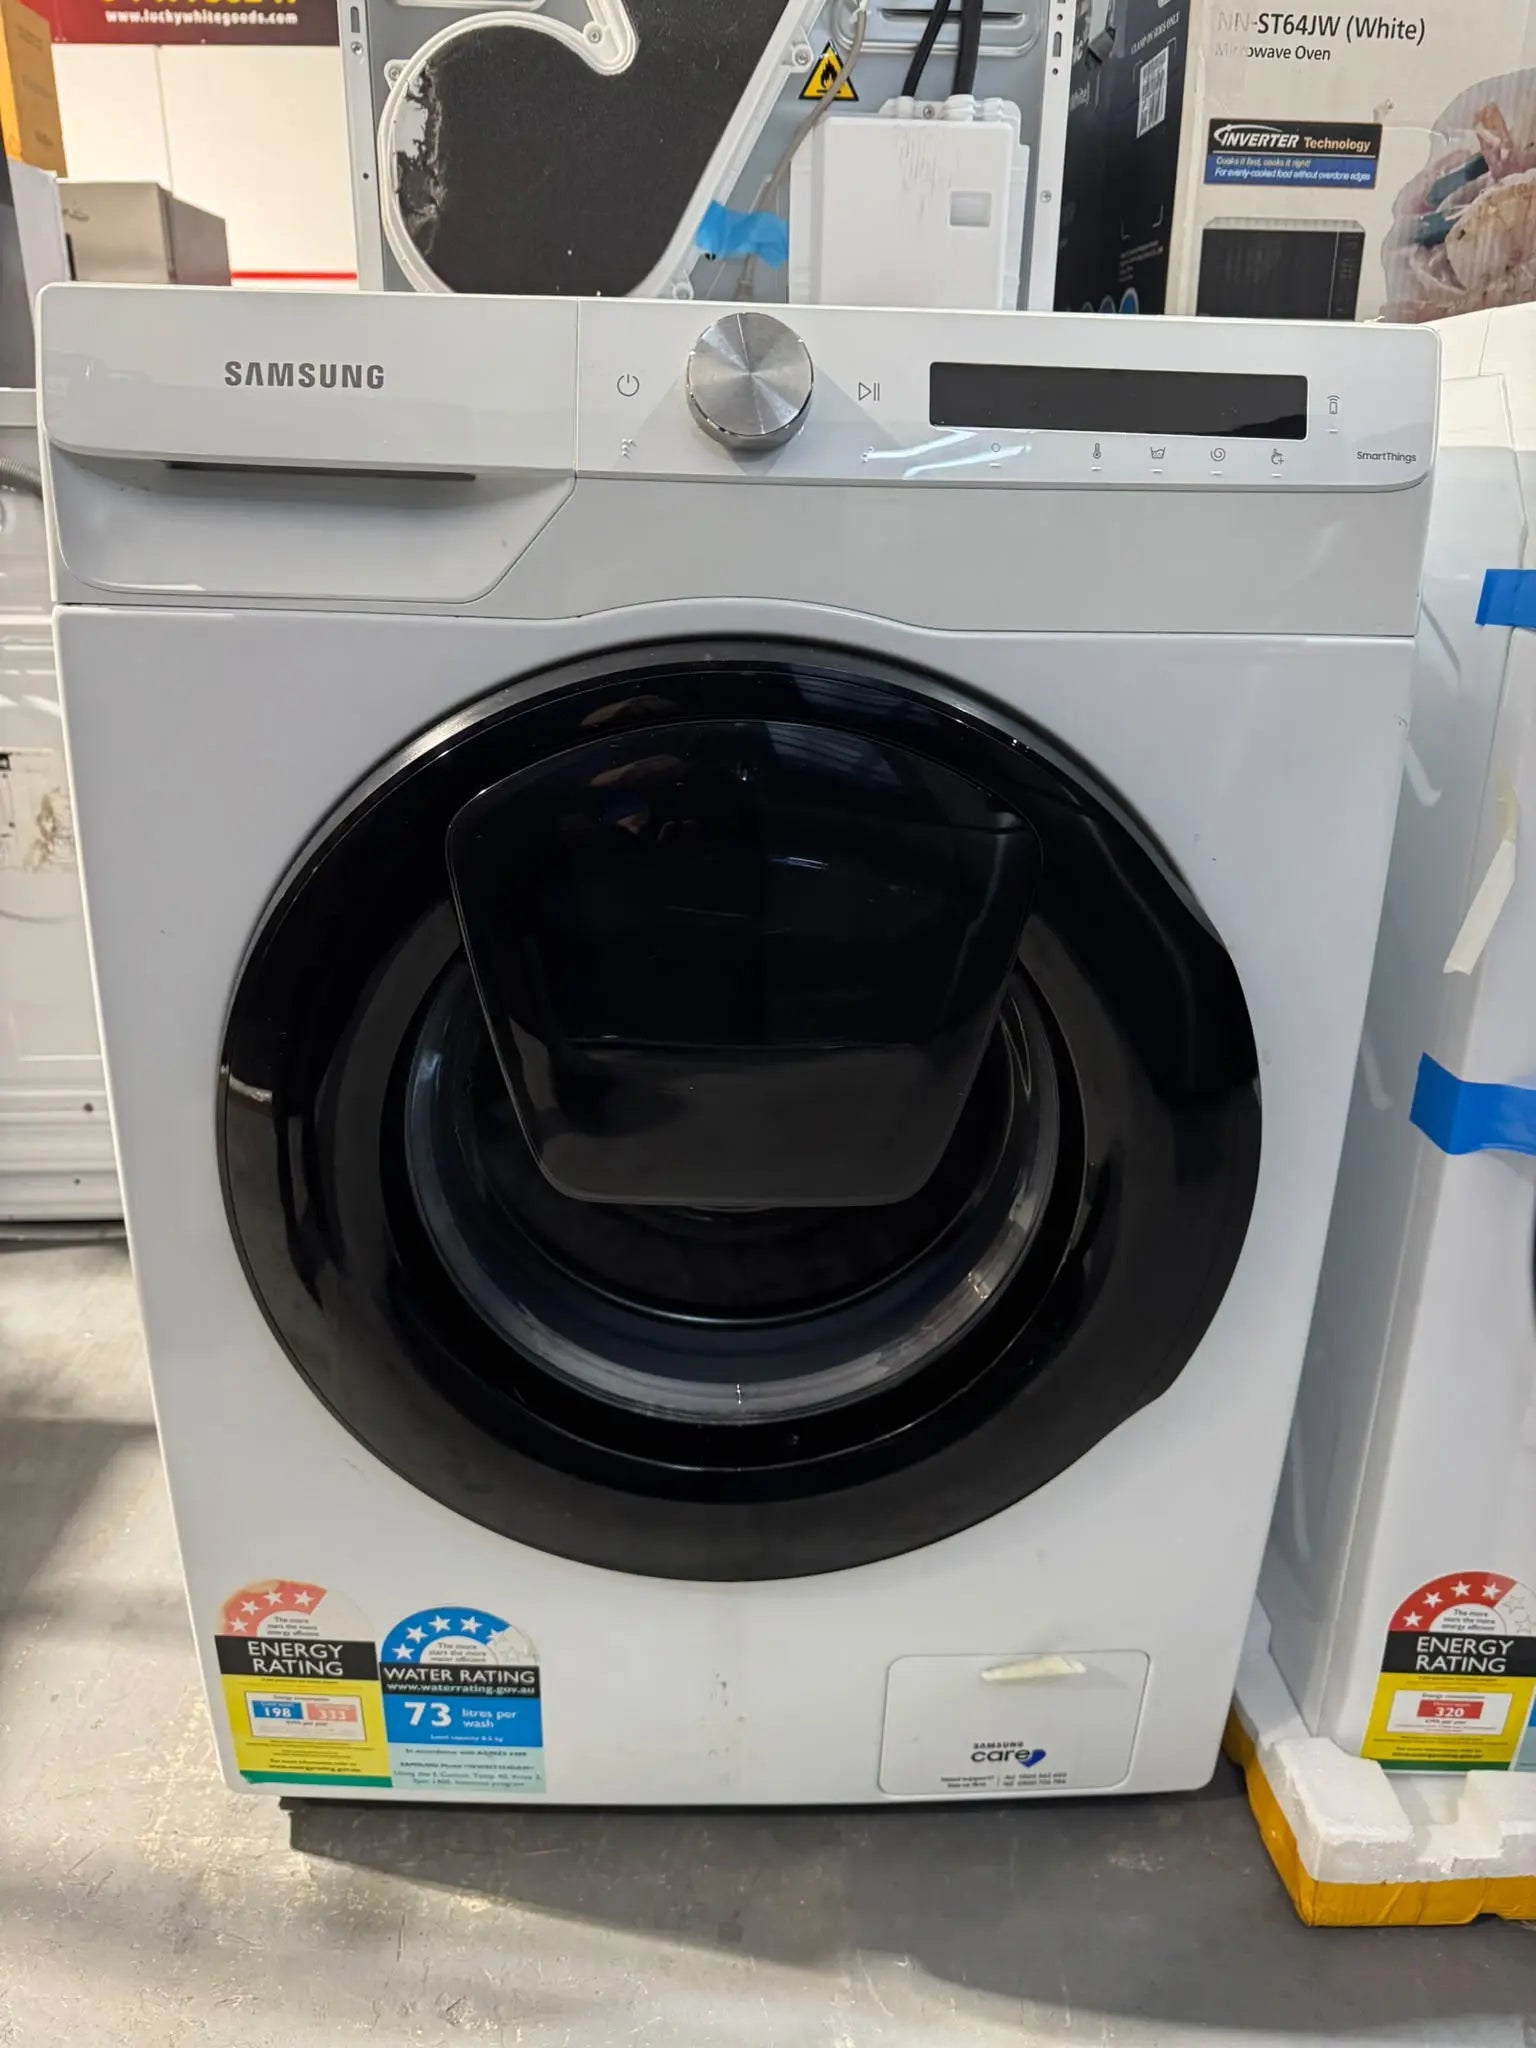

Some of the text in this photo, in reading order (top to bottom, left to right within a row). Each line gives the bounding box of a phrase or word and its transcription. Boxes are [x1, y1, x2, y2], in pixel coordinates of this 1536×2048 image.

[105, 8, 298, 27] www.luckywhitegoods.com
[1216, 11, 1426, 46] NN-ST64JW (White)
[1295, 46, 1331, 61] Oven
[1217, 128, 1371, 152] INVERTER Technology
[224, 360, 385, 390] SAMSUNG
[1356, 451, 1417, 464] SmartThings
[247, 1640, 344, 1659] ENERGY
[1416, 1635, 1514, 1655] ENERGY
[252, 1658, 344, 1676] RATING
[1415, 1655, 1507, 1673] RATING
[384, 1667, 535, 1684] WATER RATING
[386, 1682, 535, 1695] www.waterrating.gov.au
[264, 1706, 292, 1718] 198
[404, 1701, 517, 1727] 73 litres per
[1435, 1707, 1465, 1717] 320
[462, 1718, 494, 1728] wash
[973, 1741, 1024, 1749] SAMSUNG
[971, 1749, 1031, 1763] care
